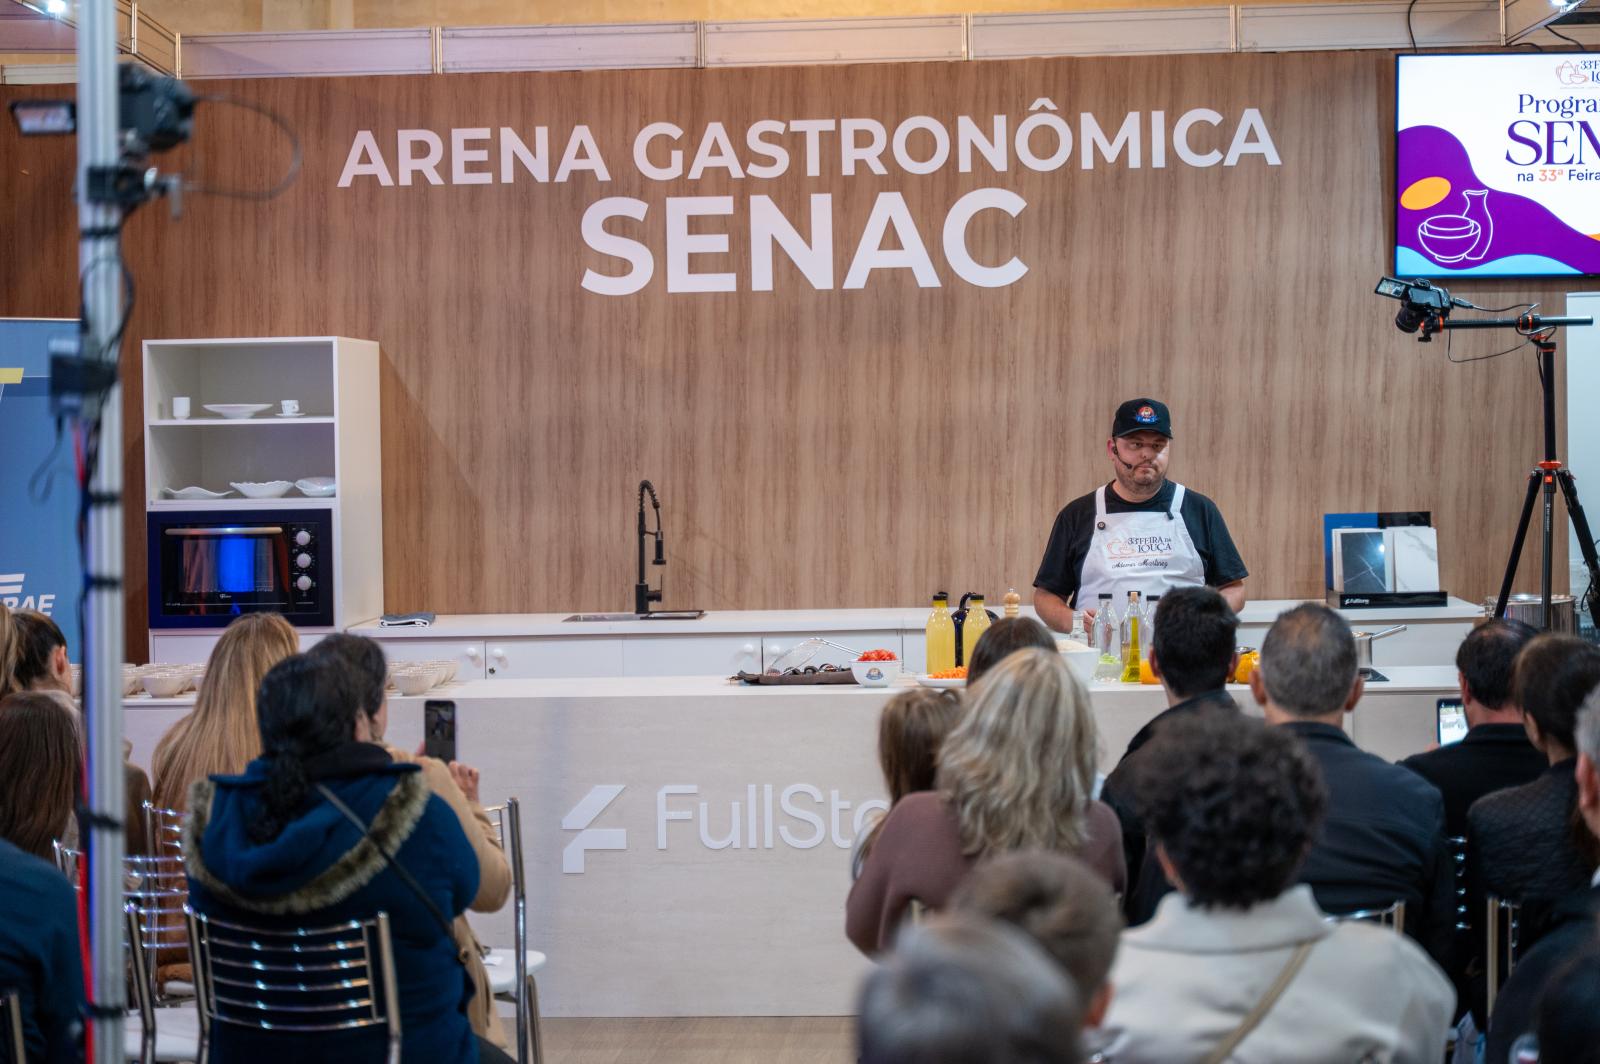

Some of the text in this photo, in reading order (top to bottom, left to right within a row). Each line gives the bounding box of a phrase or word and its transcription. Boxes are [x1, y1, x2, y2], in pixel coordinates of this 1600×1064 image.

[1518, 93, 1600, 119] Progra
[337, 97, 1282, 187] ARENA GASTRONÔMICA
[1505, 119, 1600, 166] SEN
[1517, 168, 1600, 182] na 33ª Feira
[580, 187, 1029, 296] SENAC
